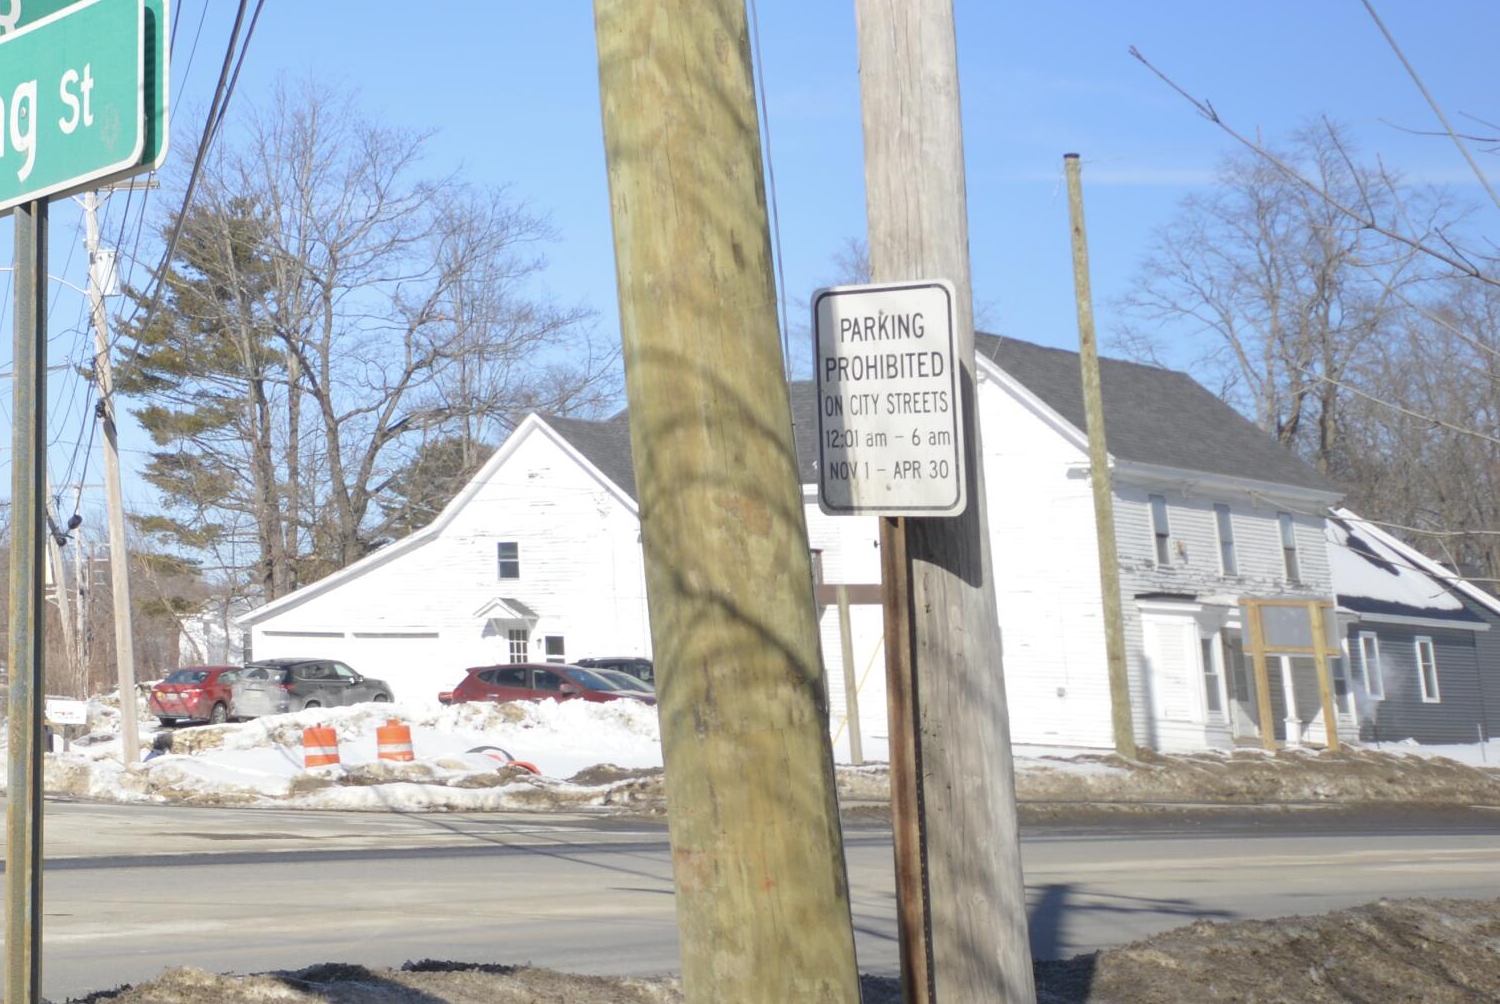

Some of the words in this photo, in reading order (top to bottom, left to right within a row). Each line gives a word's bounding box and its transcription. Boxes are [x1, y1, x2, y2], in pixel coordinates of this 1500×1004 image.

[58, 62, 94, 135] St
[840, 312, 925, 343] PARKING
[825, 351, 944, 383] PROHIBITED
[825, 394, 844, 417] ON
[850, 393, 880, 416] CITY
[886, 390, 949, 415] STREETS
[825, 429, 859, 448] 12:01
[866, 432, 887, 447] am
[911, 428, 921, 446] 6
[928, 430, 951, 446] am
[829, 461, 858, 480] NOV
[893, 460, 922, 479] APR
[929, 459, 949, 479] 30
